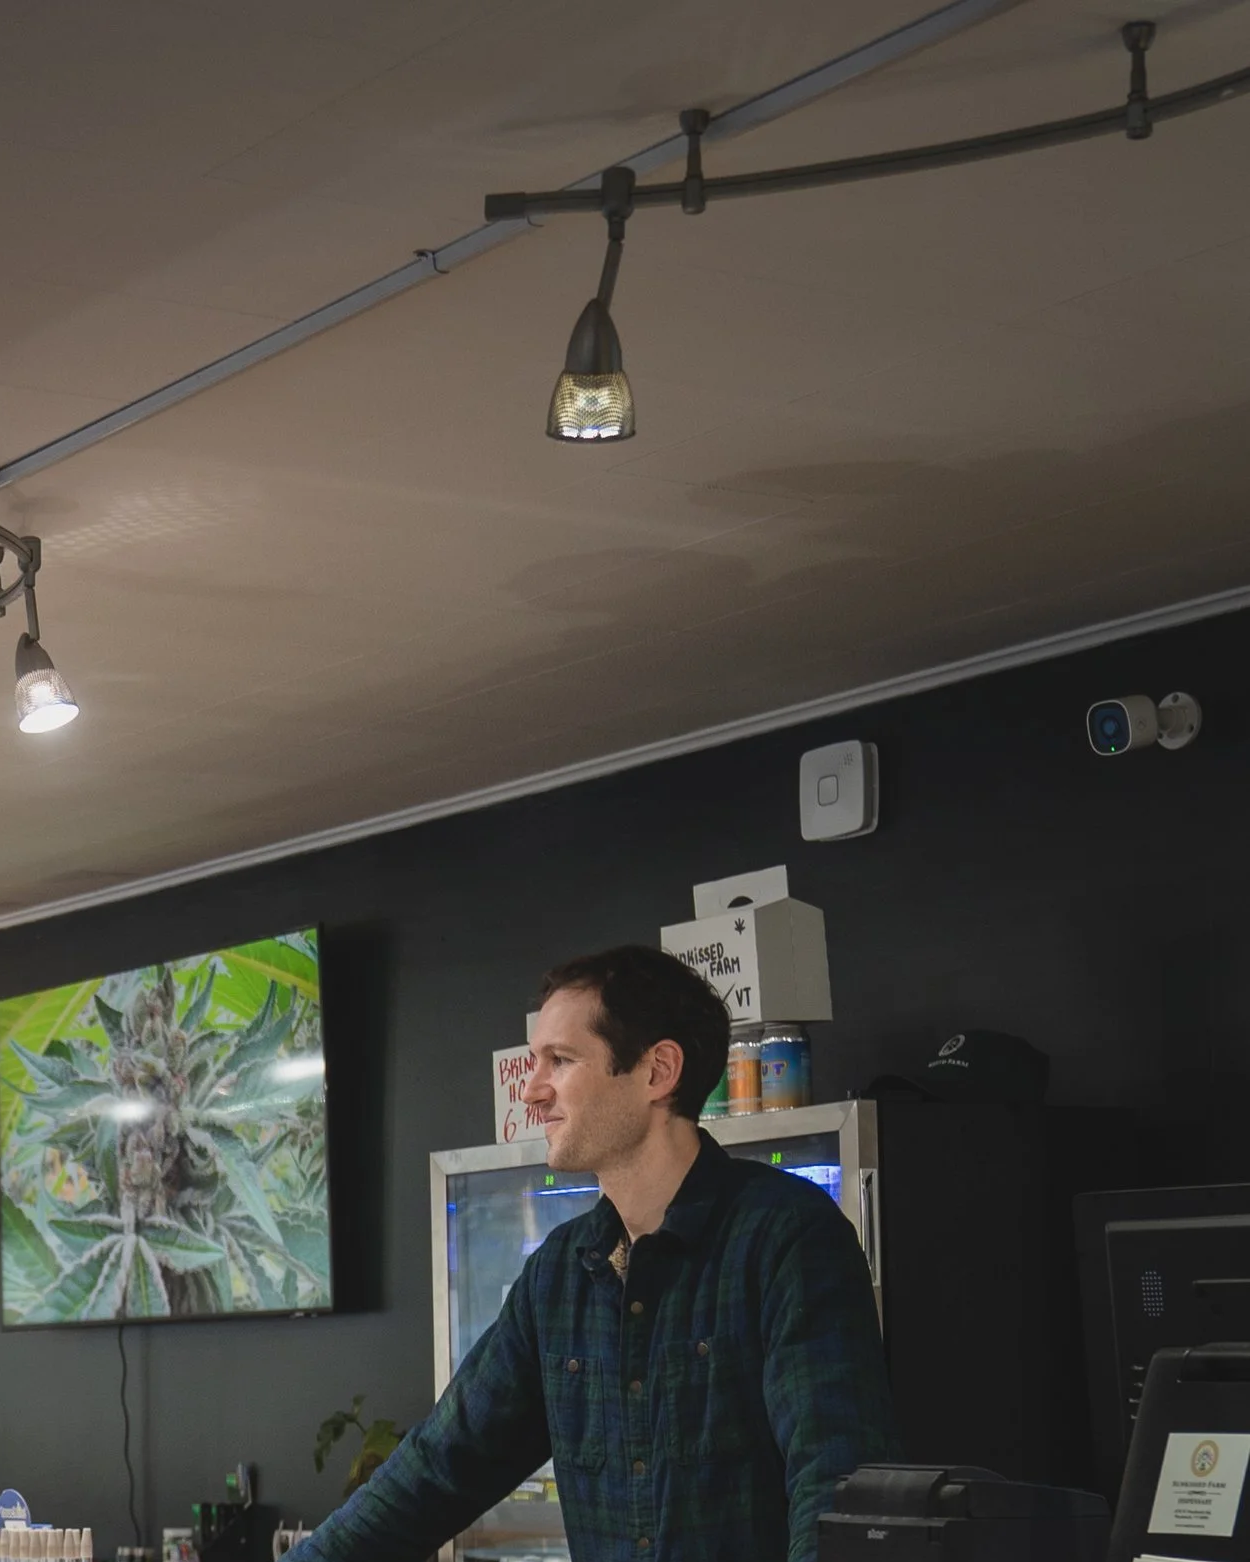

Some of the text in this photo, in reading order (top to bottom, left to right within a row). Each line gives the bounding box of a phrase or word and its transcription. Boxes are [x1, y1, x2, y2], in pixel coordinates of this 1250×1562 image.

[710, 957, 740, 977] FARM
[735, 987, 751, 1007] VT
[499, 1053, 534, 1086] BRIN
